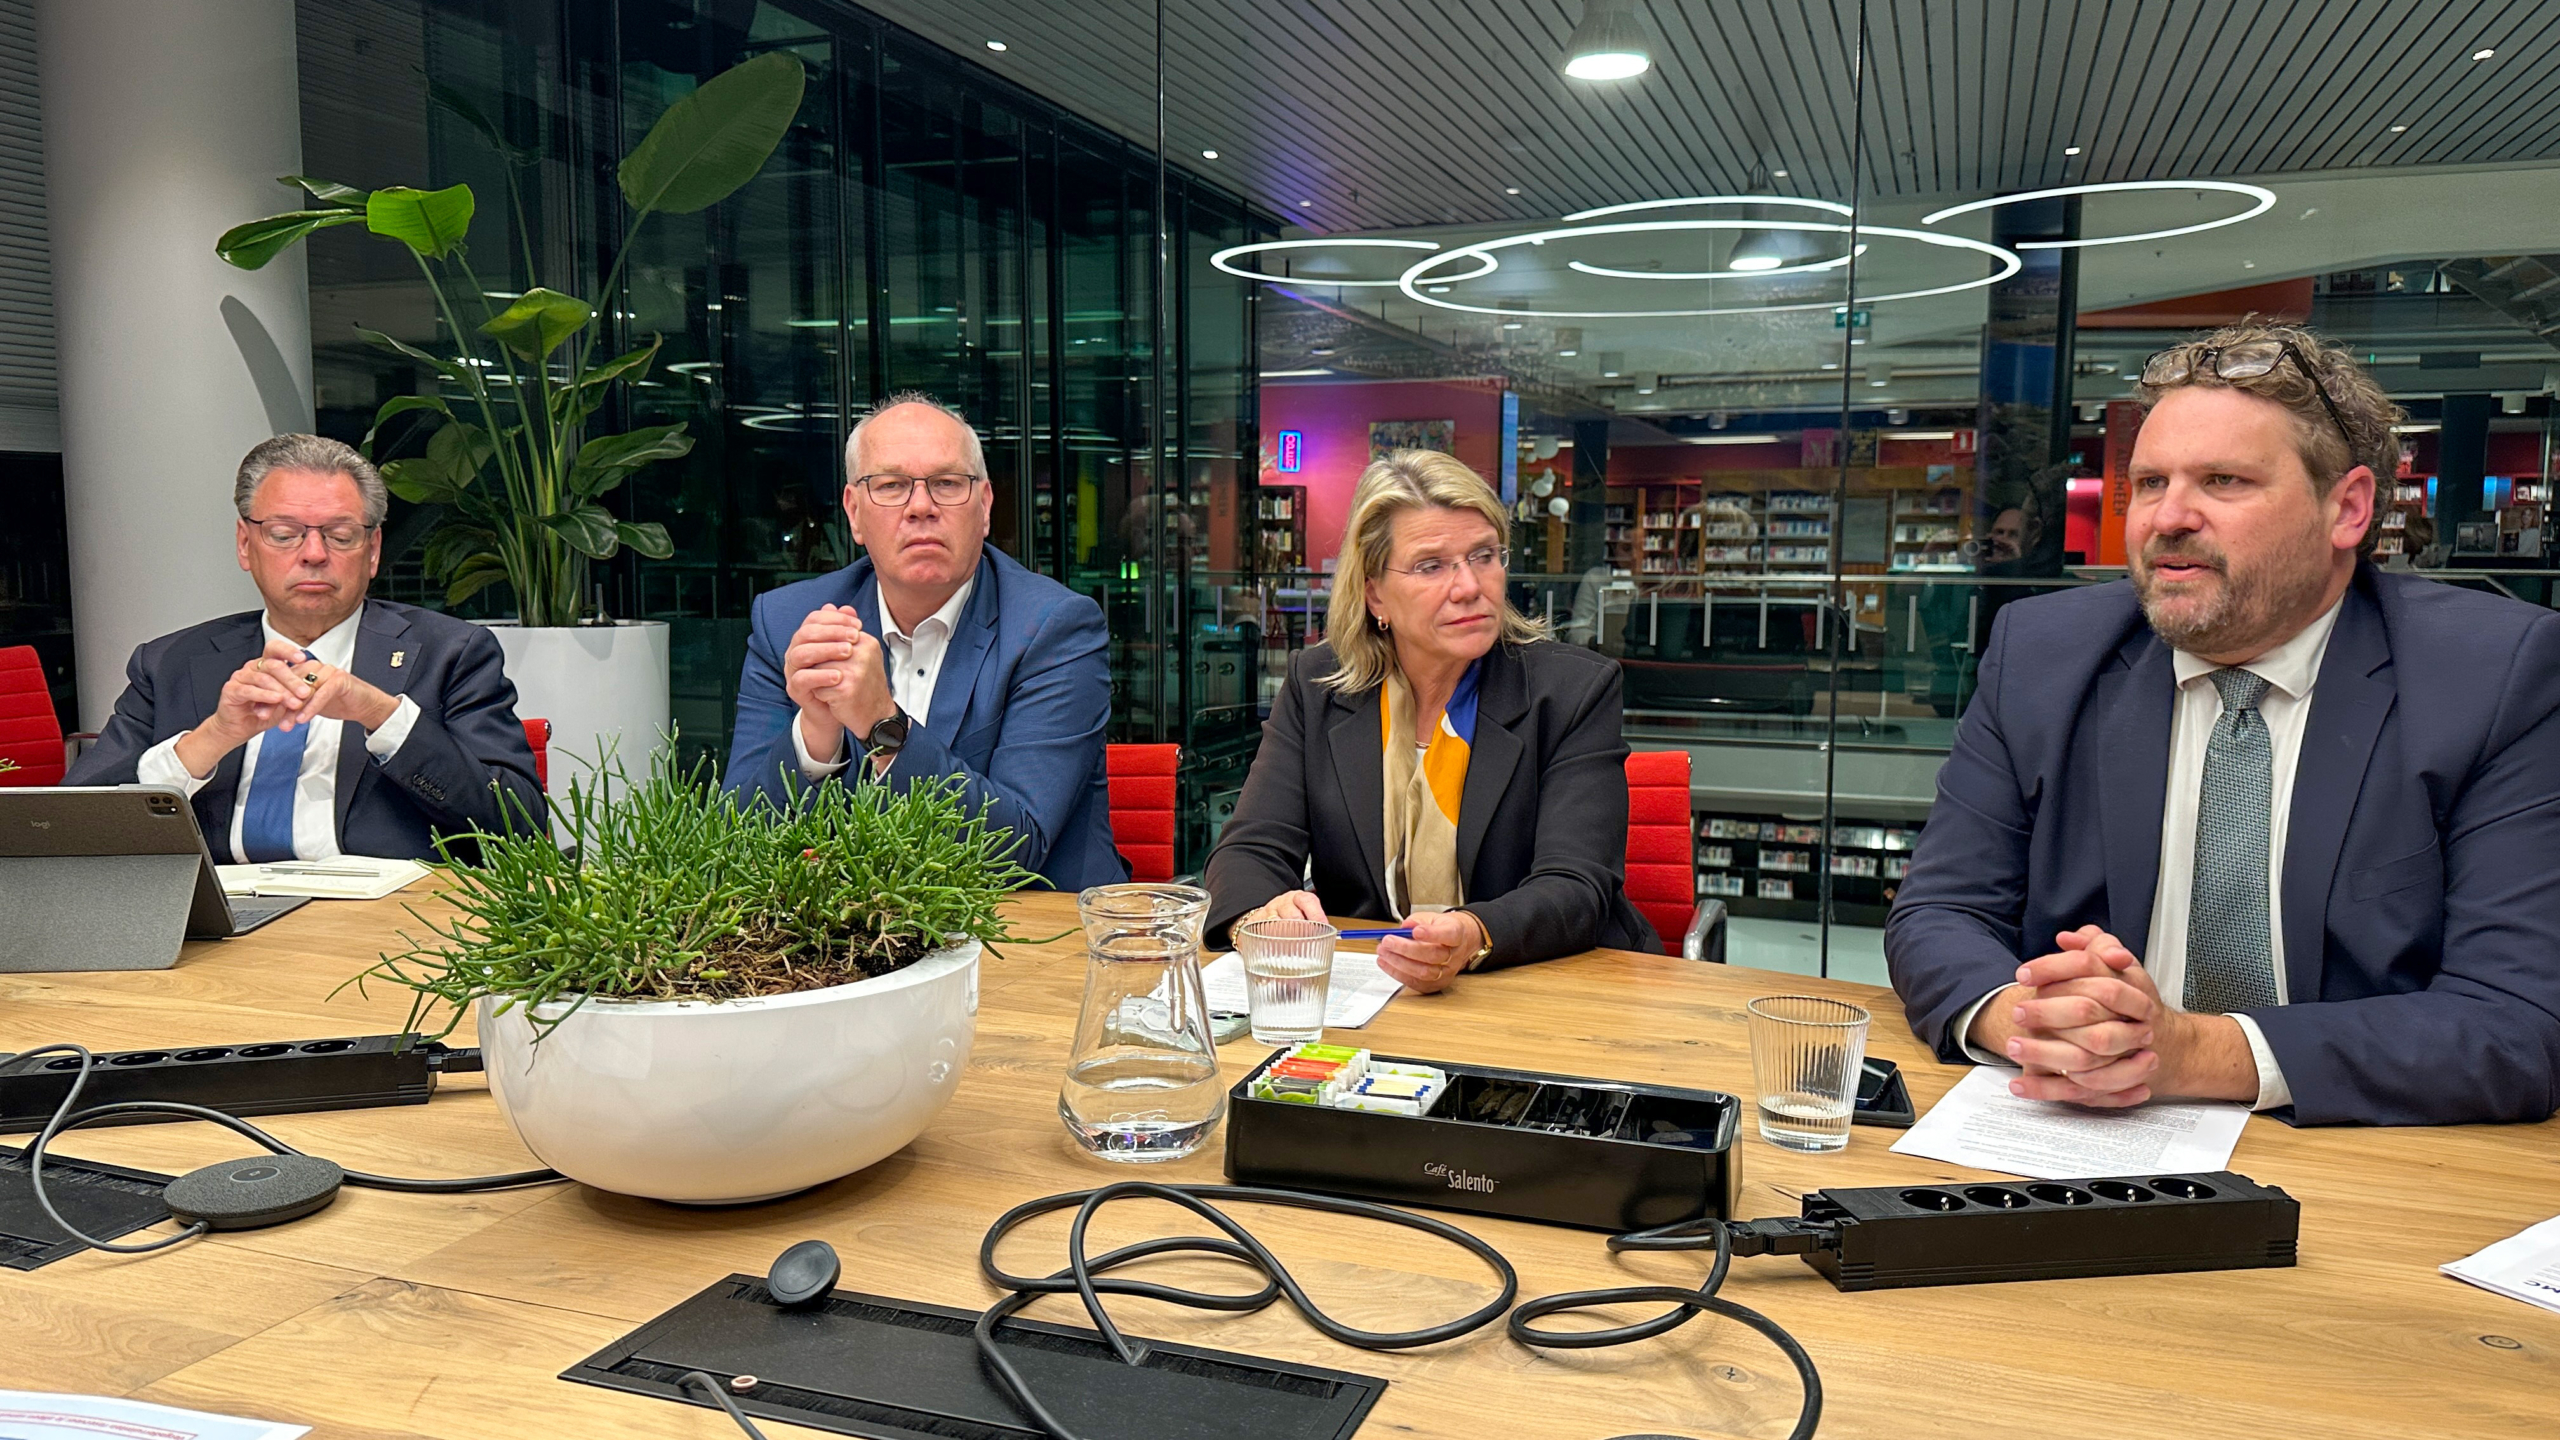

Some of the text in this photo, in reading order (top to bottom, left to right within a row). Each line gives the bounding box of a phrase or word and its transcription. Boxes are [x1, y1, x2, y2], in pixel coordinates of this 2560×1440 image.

[1285, 434, 1296, 469] OPEN
[30, 820, 51, 830] logi
[1424, 1162, 1495, 1194] Café Salento
